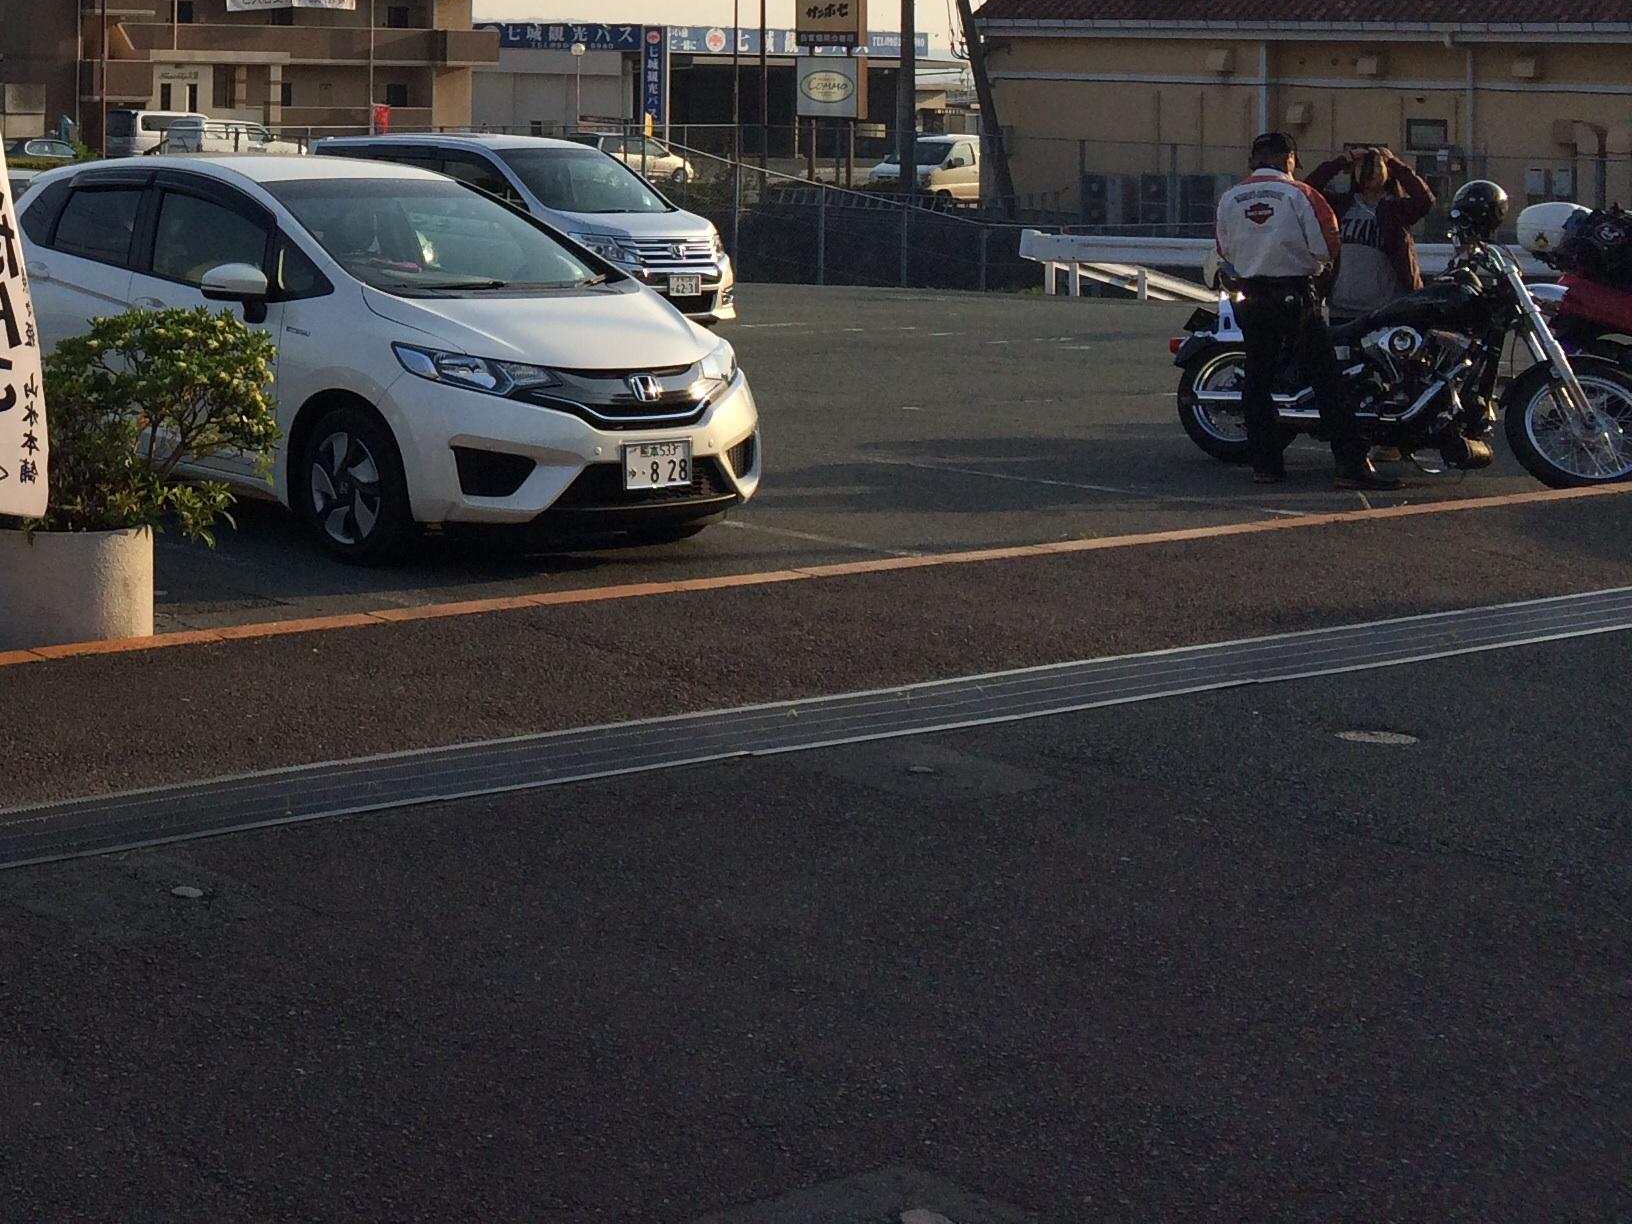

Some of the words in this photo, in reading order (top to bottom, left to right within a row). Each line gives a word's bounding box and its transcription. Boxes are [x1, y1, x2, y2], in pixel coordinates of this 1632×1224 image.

[506, 25, 634, 43] 七城観光バス
